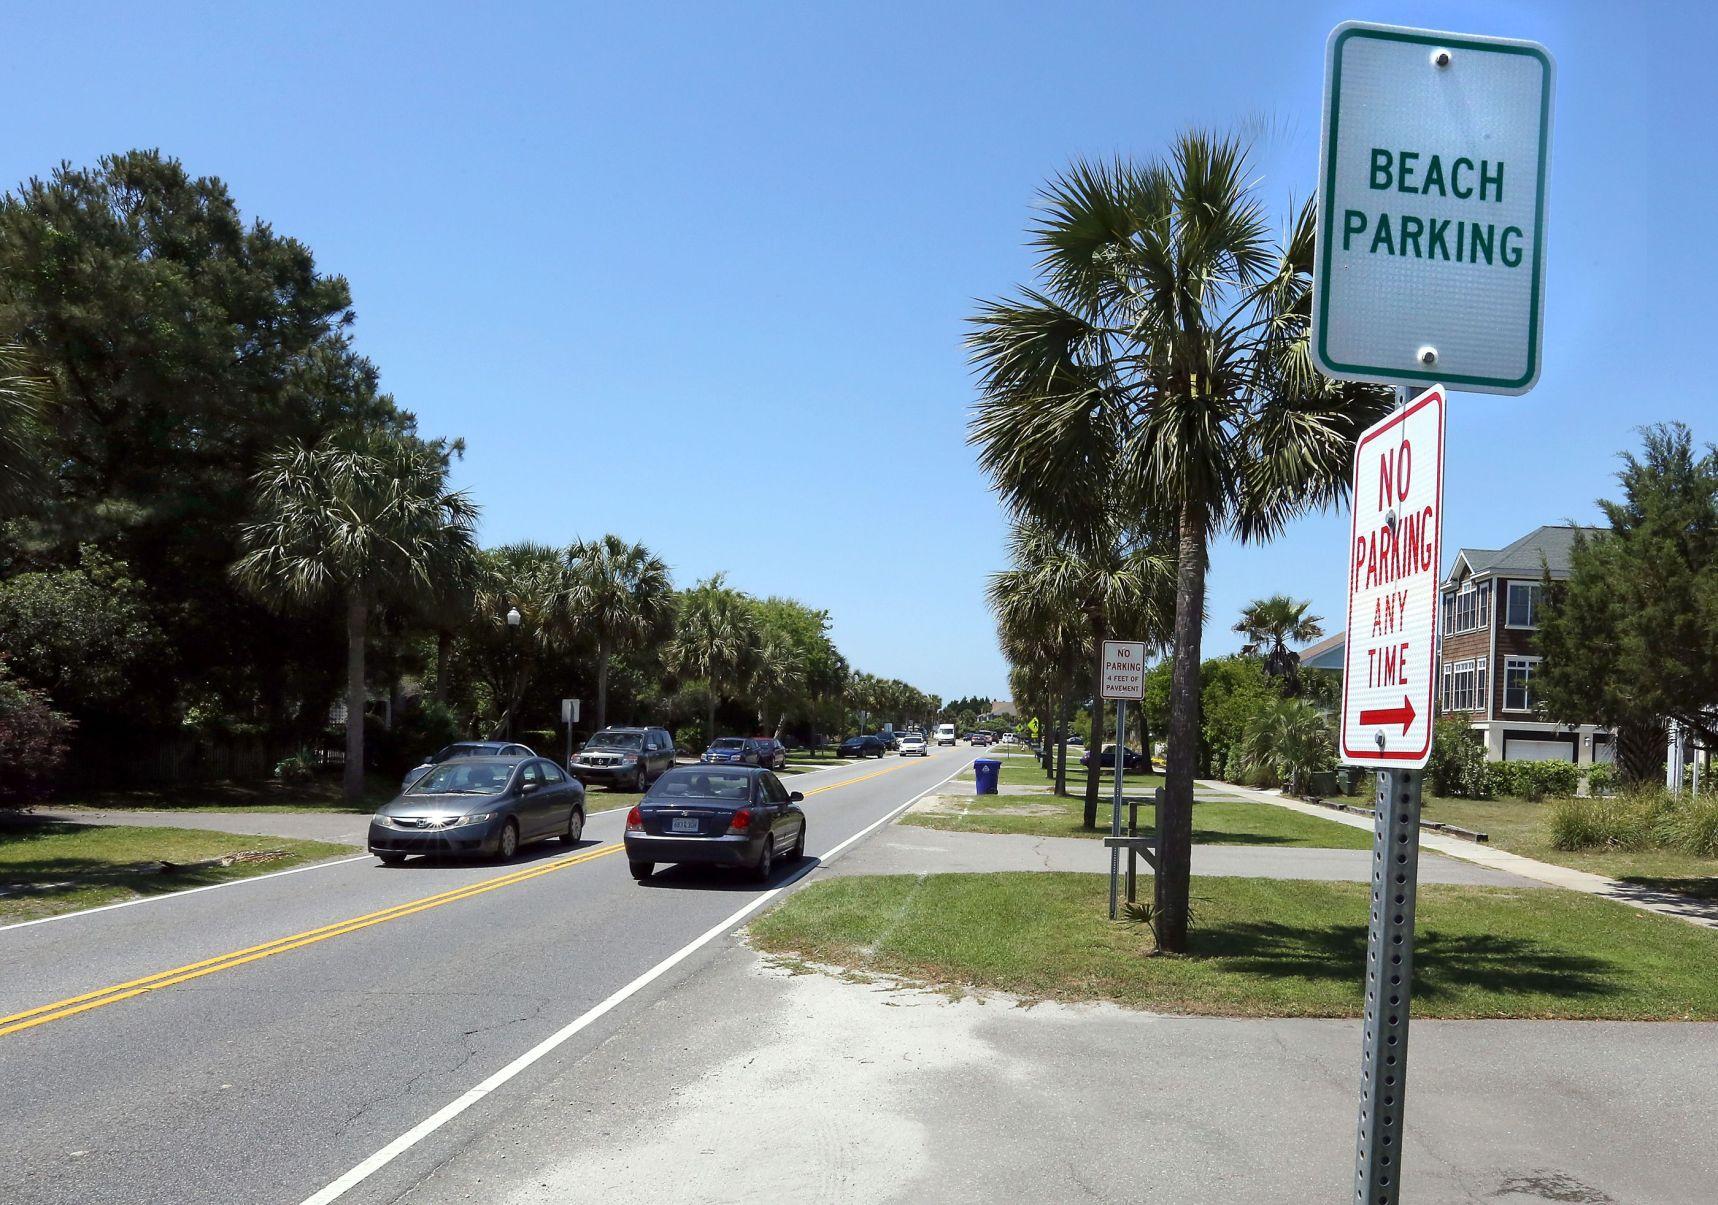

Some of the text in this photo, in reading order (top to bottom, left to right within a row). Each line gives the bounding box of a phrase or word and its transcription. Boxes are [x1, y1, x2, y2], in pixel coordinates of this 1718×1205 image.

[1369, 148, 1504, 202] BEACH
[1343, 209, 1524, 268] PARKING
[1378, 439, 1412, 512] NO
[1355, 505, 1433, 593] PARKING
[1372, 589, 1408, 637] ANY
[1106, 661, 1141, 672] PARKING
[1117, 649, 1131, 658] NO
[1368, 642, 1409, 689] TIME
[1106, 684, 1139, 692] PAVEMENT
